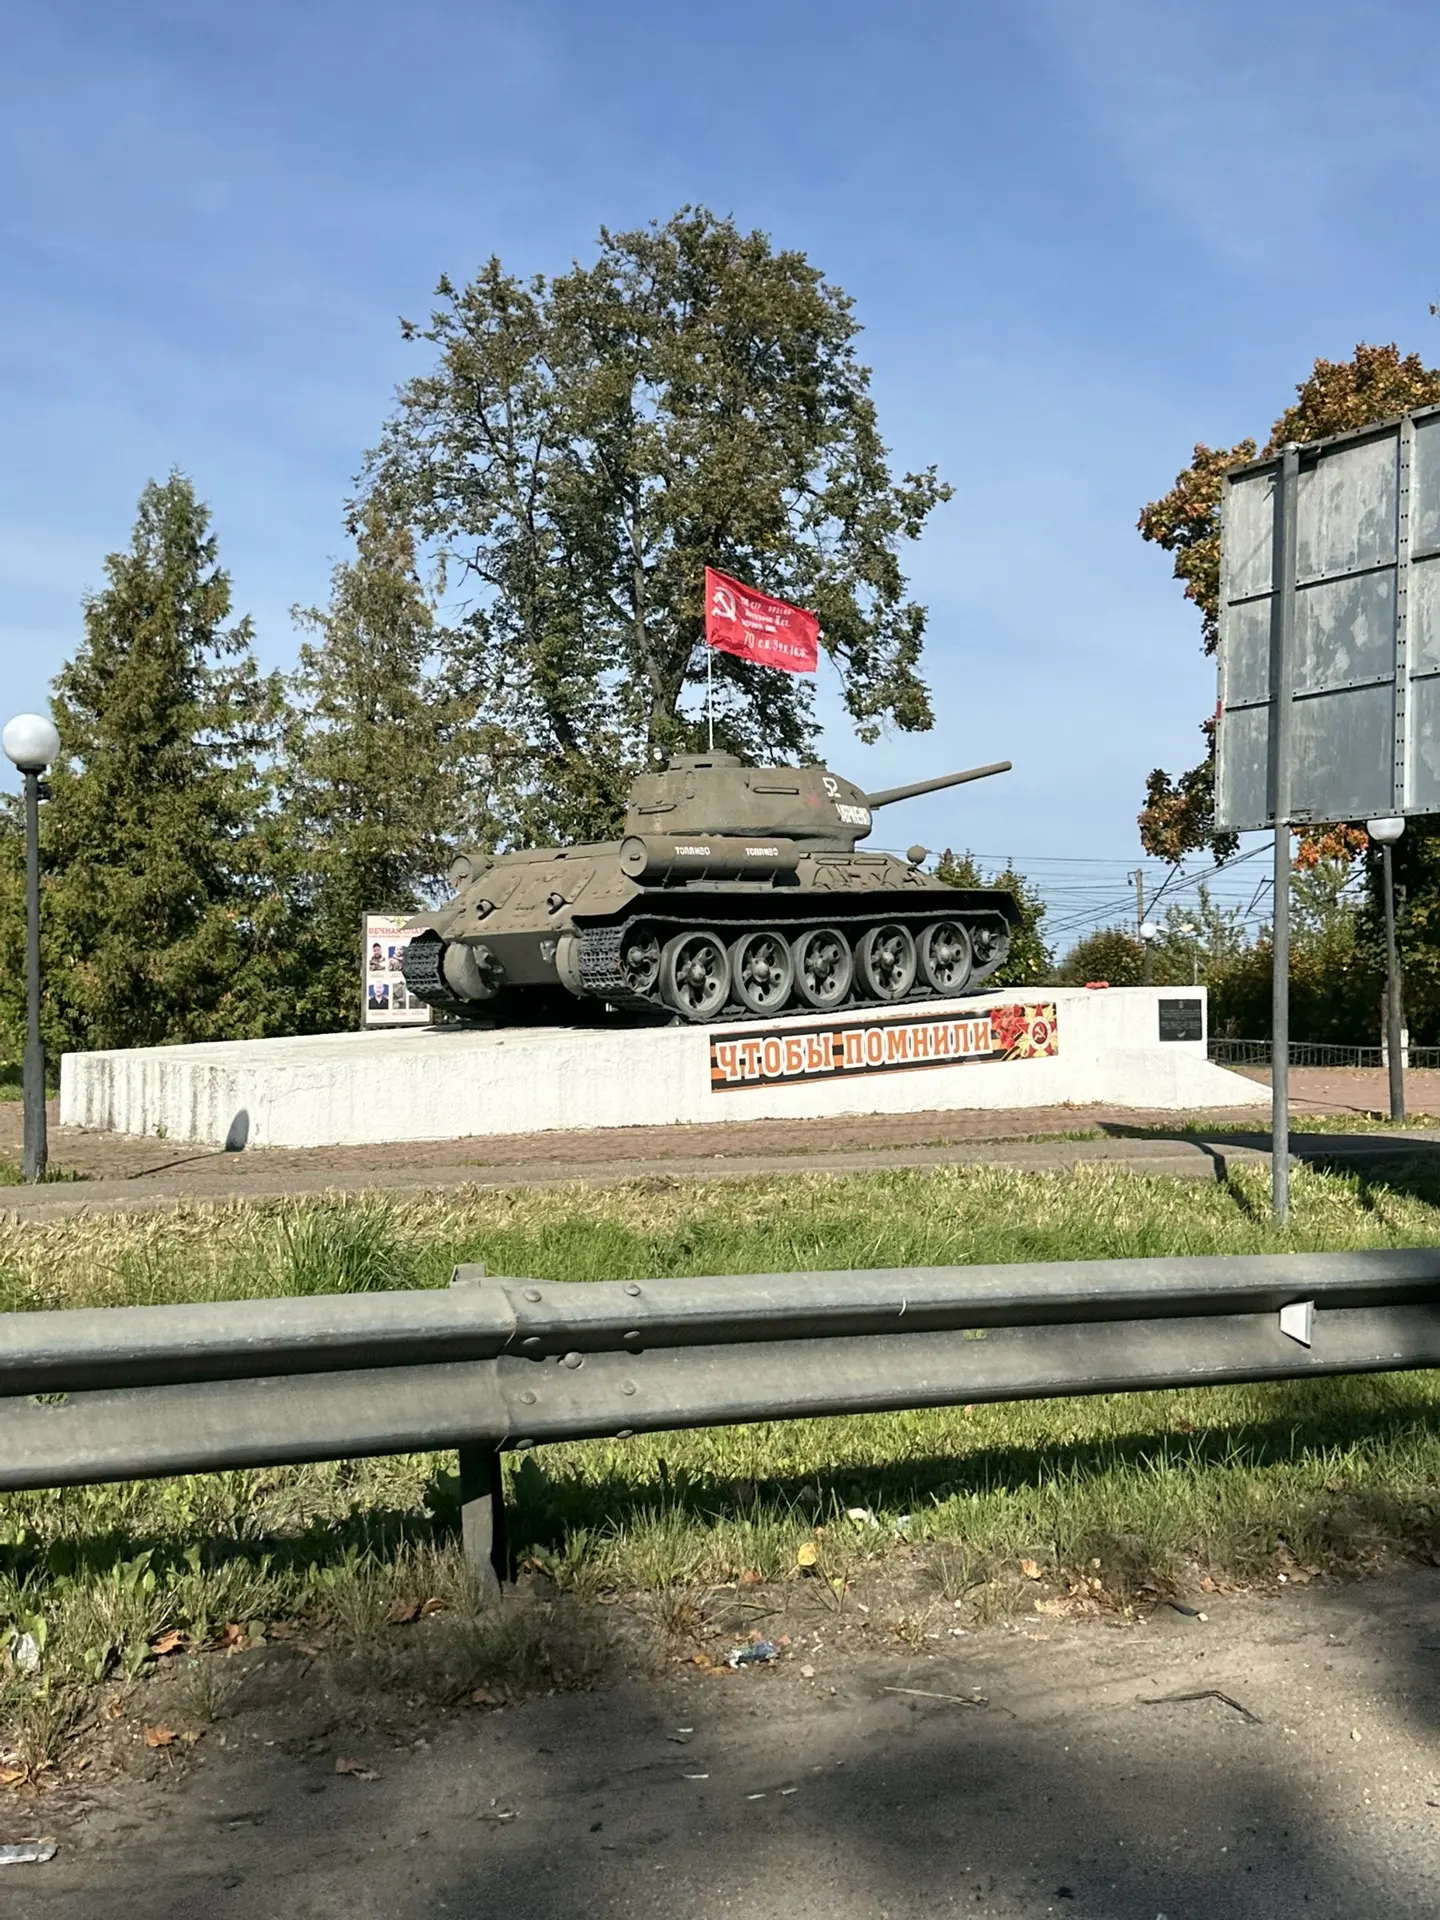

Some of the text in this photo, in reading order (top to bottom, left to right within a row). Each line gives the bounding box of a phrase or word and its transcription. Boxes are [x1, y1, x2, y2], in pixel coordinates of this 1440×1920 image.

[674, 846, 779, 857] ТОПЛИВО ТОПЛИВО
[715, 1018, 993, 1081] ЧТОБЫ ПОМНИЛИ
